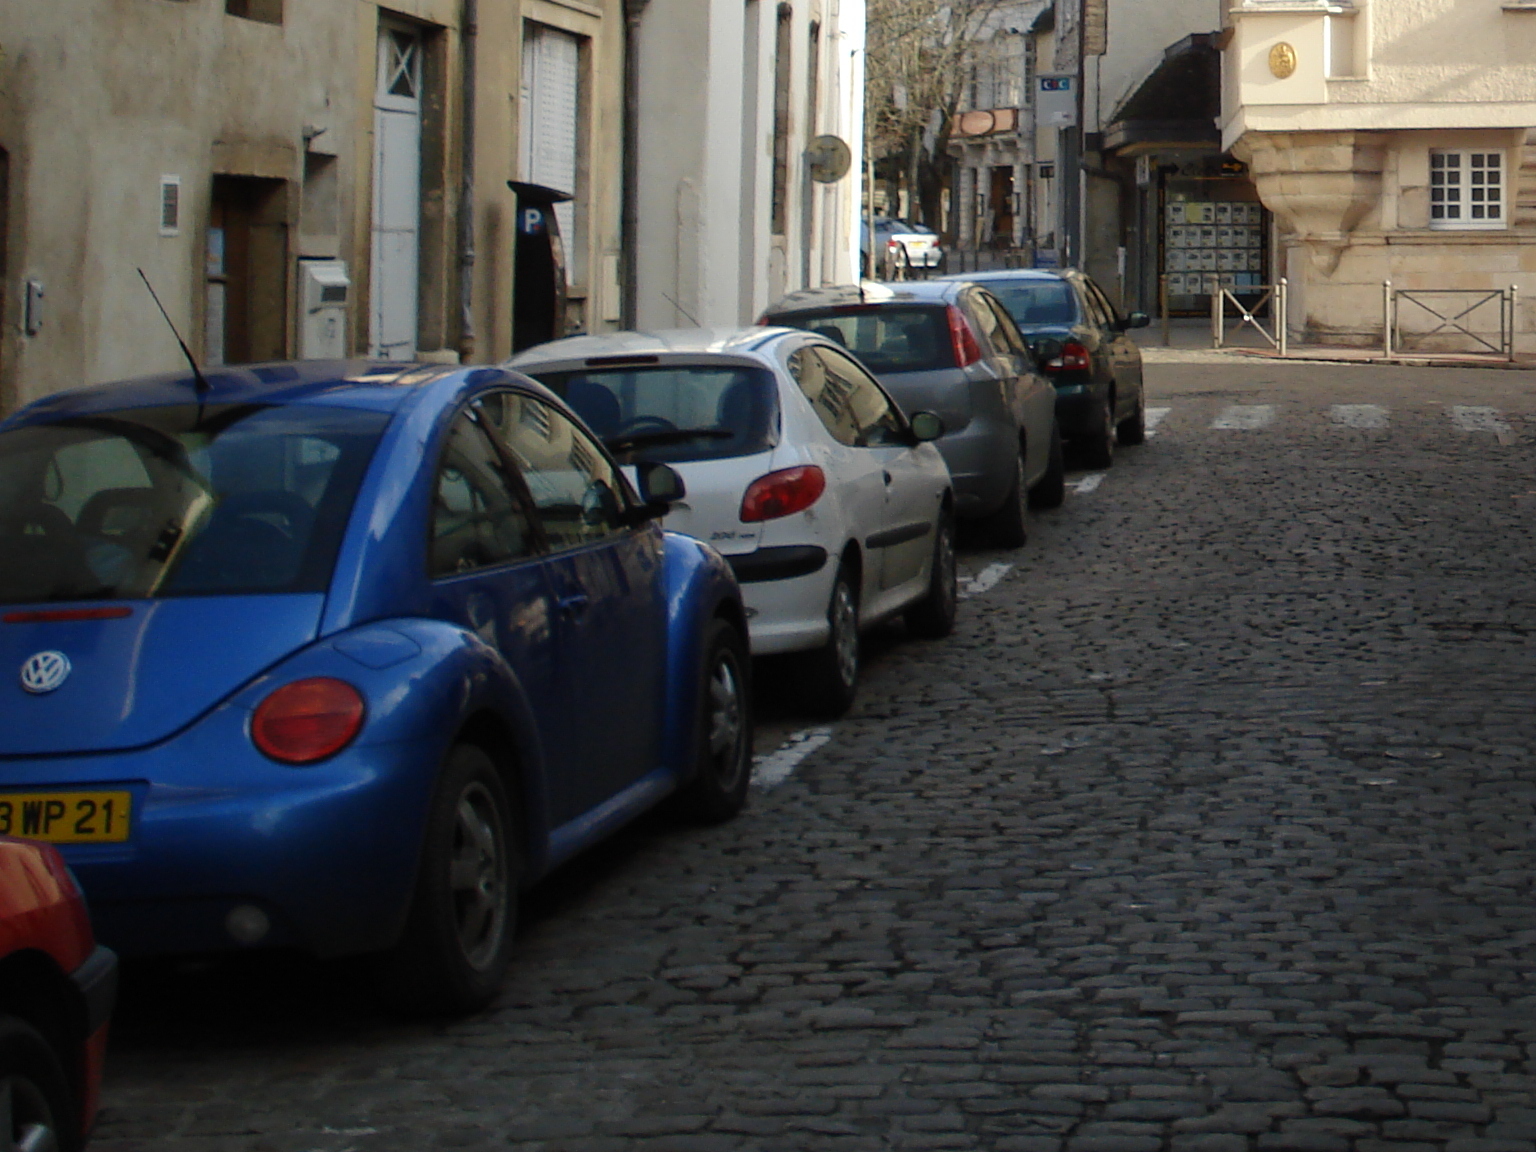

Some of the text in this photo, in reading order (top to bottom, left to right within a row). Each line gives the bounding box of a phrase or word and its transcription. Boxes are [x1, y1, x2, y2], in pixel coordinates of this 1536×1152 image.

[525, 208, 542, 233] P
[23, 801, 64, 834] WP
[75, 800, 114, 834] 21
